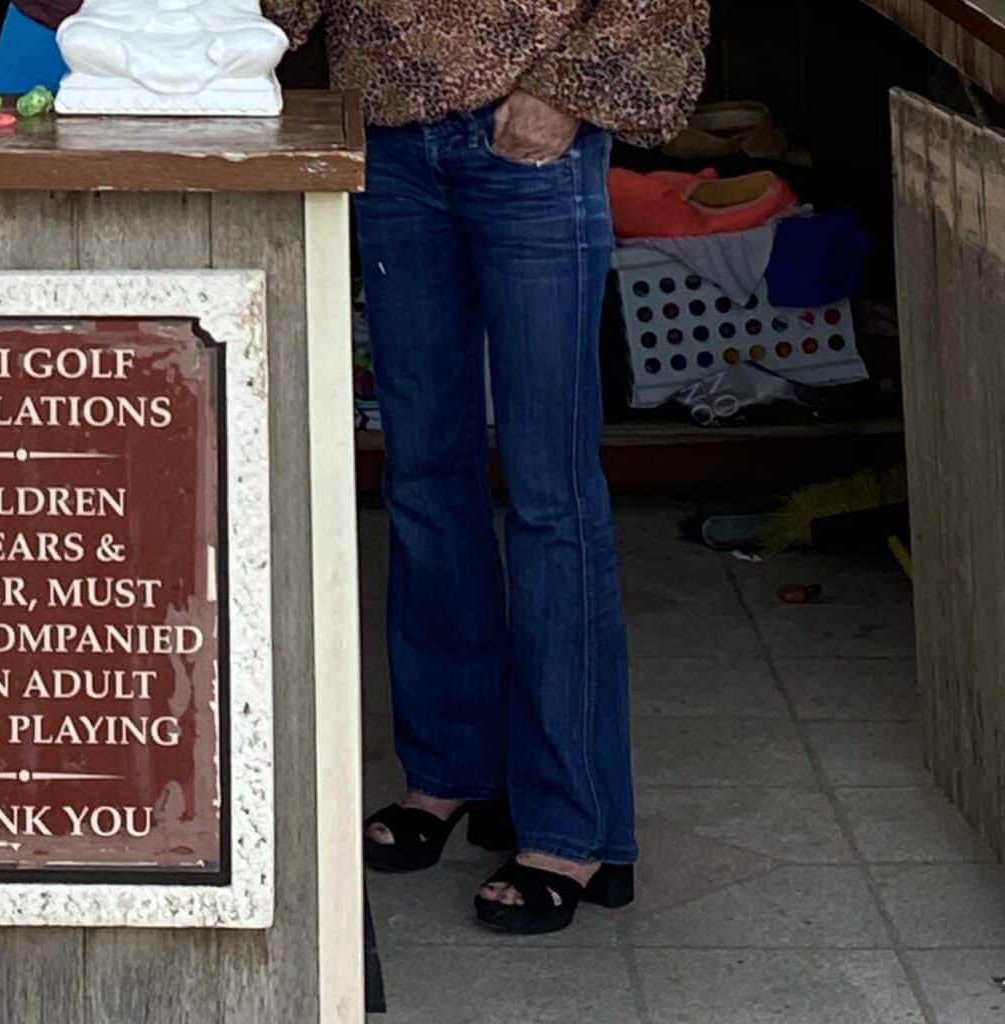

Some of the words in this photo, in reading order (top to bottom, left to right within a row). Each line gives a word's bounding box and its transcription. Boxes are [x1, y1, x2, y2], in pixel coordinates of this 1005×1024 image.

[23, 348, 135, 379] GOLF
[96, 533, 125, 562] &
[48, 577, 162, 608] MUST
[23, 669, 157, 699] ADULT
[9, 714, 180, 746] PLAYING
[63, 806, 153, 837] YOU
